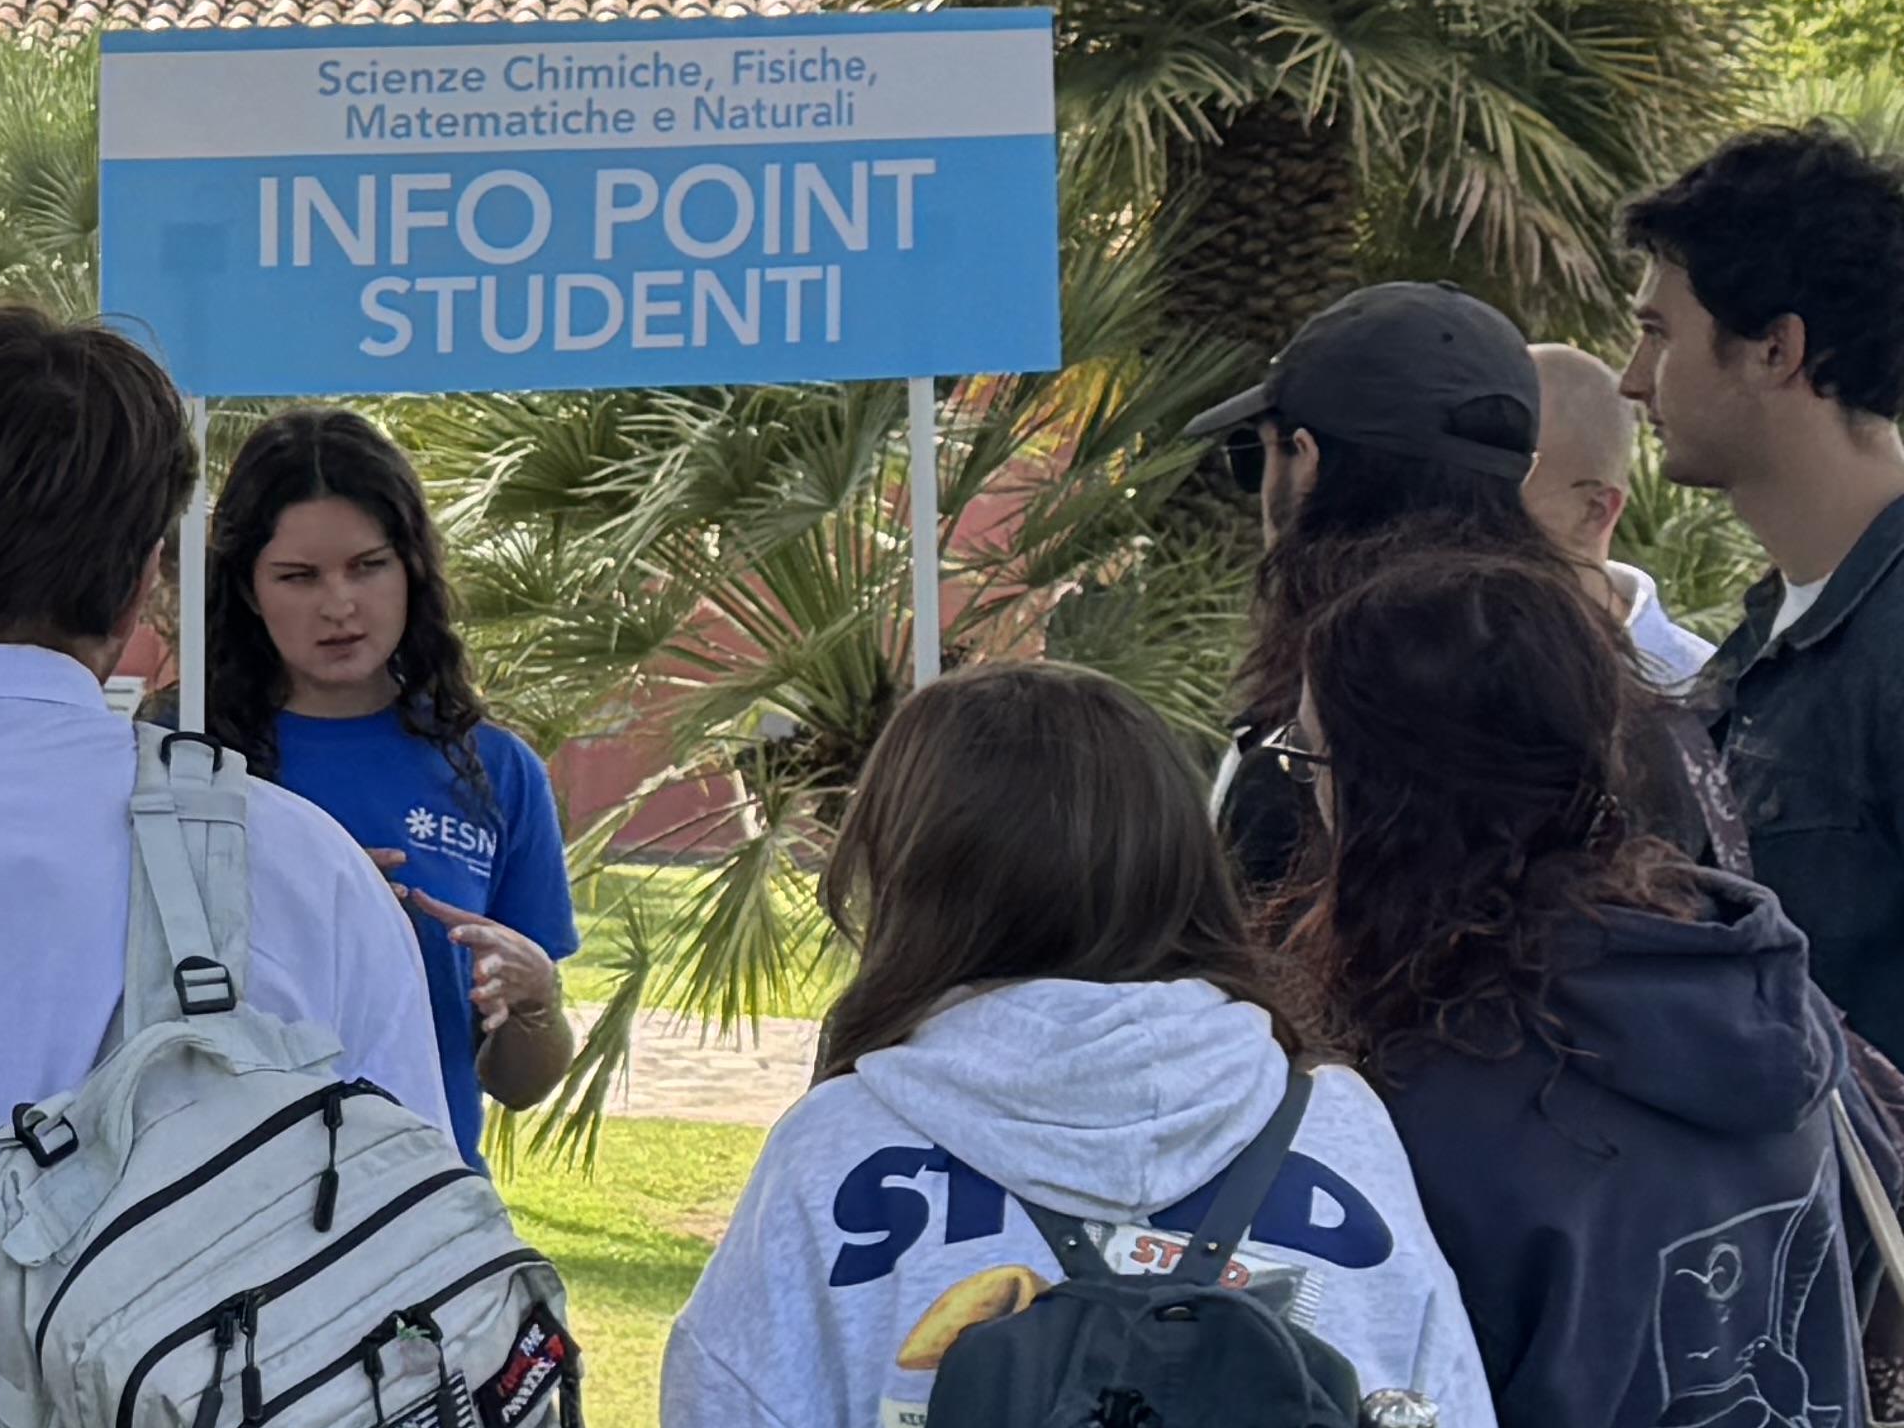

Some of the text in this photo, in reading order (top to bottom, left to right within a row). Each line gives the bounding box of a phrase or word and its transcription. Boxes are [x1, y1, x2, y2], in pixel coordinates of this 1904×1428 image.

[317, 47, 879, 96] Scienze Chimiche, Fisiche,
[345, 92, 855, 141] Matematiche e Naturali
[258, 158, 936, 268] INFO POINT
[359, 264, 841, 357] STUDENTI
[440, 815, 497, 858] ESN
